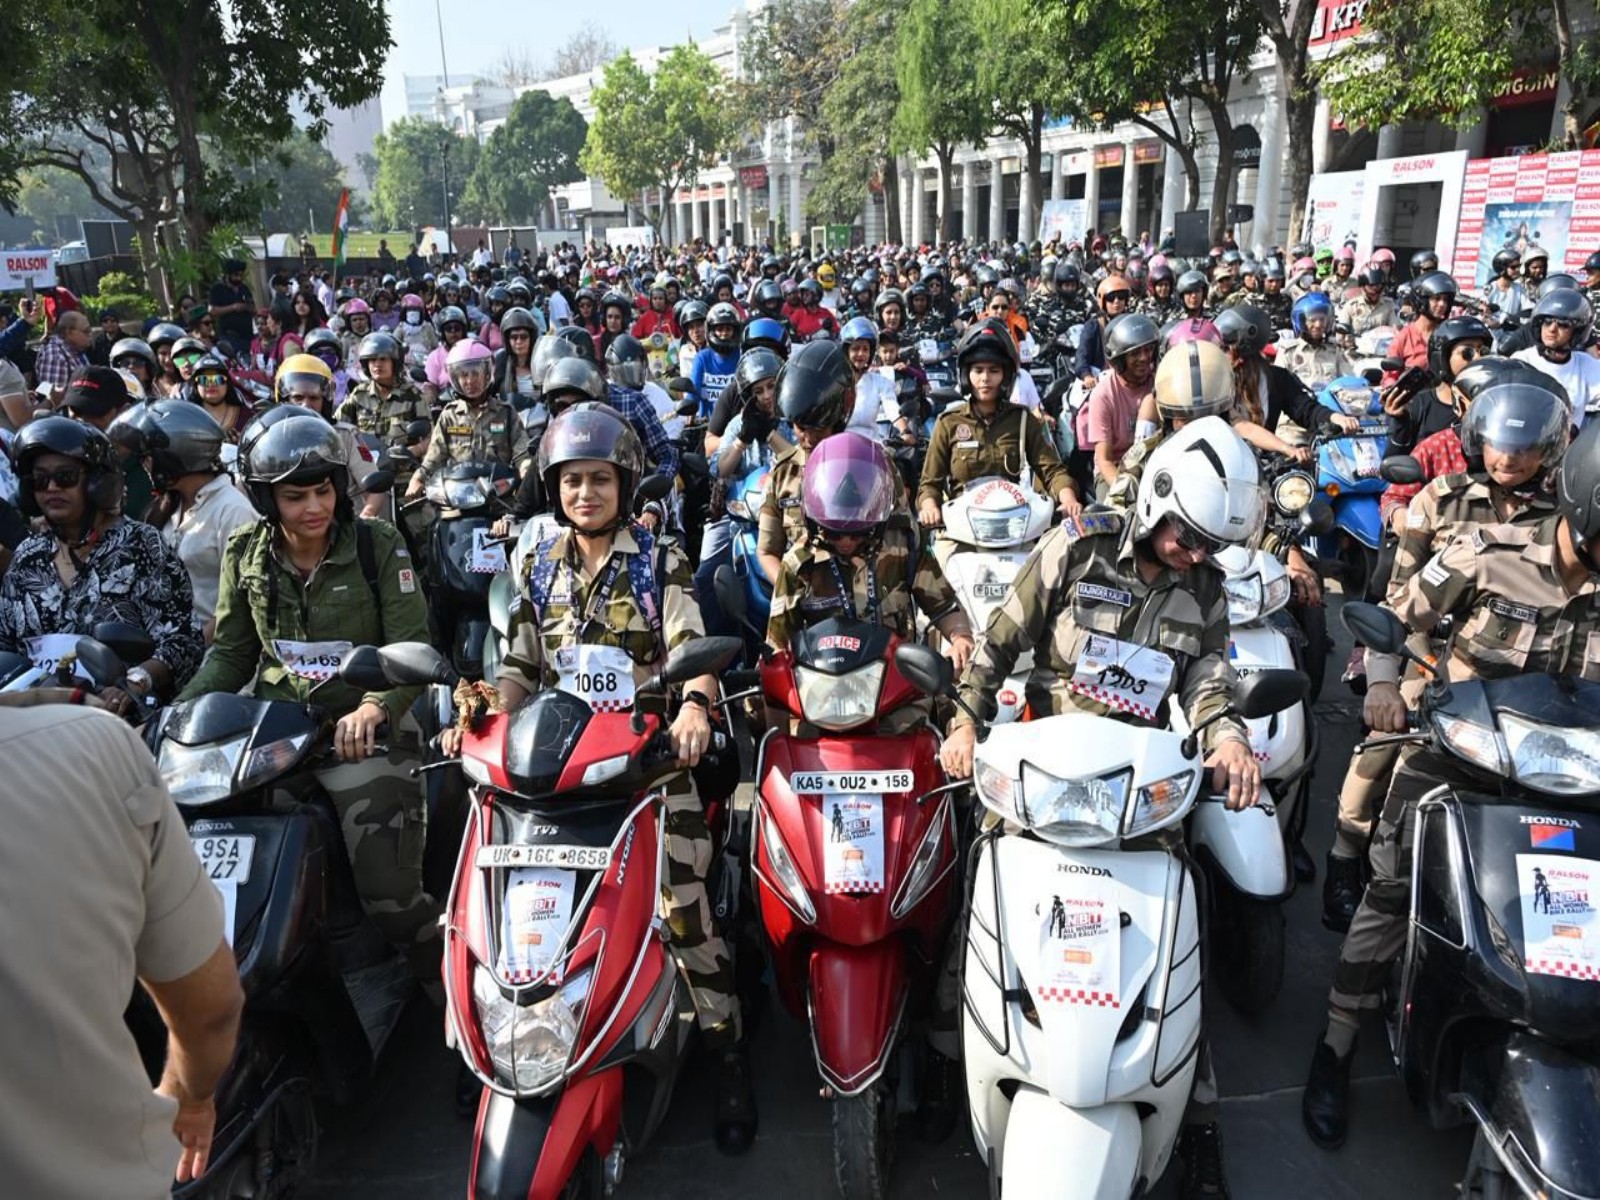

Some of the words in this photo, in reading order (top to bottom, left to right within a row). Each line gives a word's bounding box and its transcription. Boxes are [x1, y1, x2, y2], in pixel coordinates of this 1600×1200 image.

[1393, 159, 1435, 172] RALSON
[6, 257, 48, 271] RALSON
[998, 480, 1026, 506] POLICE
[401, 571, 411, 581] 92
[819, 636, 860, 651] POLICE
[574, 672, 617, 692] 1068
[796, 777, 823, 790] KA5
[840, 776, 867, 790] 0U2
[885, 774, 910, 788] 158
[189, 822, 235, 833] HONDA
[1519, 815, 1582, 829] HONDA
[532, 825, 560, 835] TVS
[202, 838, 240, 859] 9SA
[492, 849, 513, 863] UK
[526, 848, 556, 863] 16C
[567, 849, 608, 865] 8658
[203, 860, 237, 878] 47
[1057, 864, 1113, 878] HONDA
[1548, 869, 1590, 880] RALSON
[529, 880, 562, 888] LSON
[1065, 899, 1104, 908] RALSON
